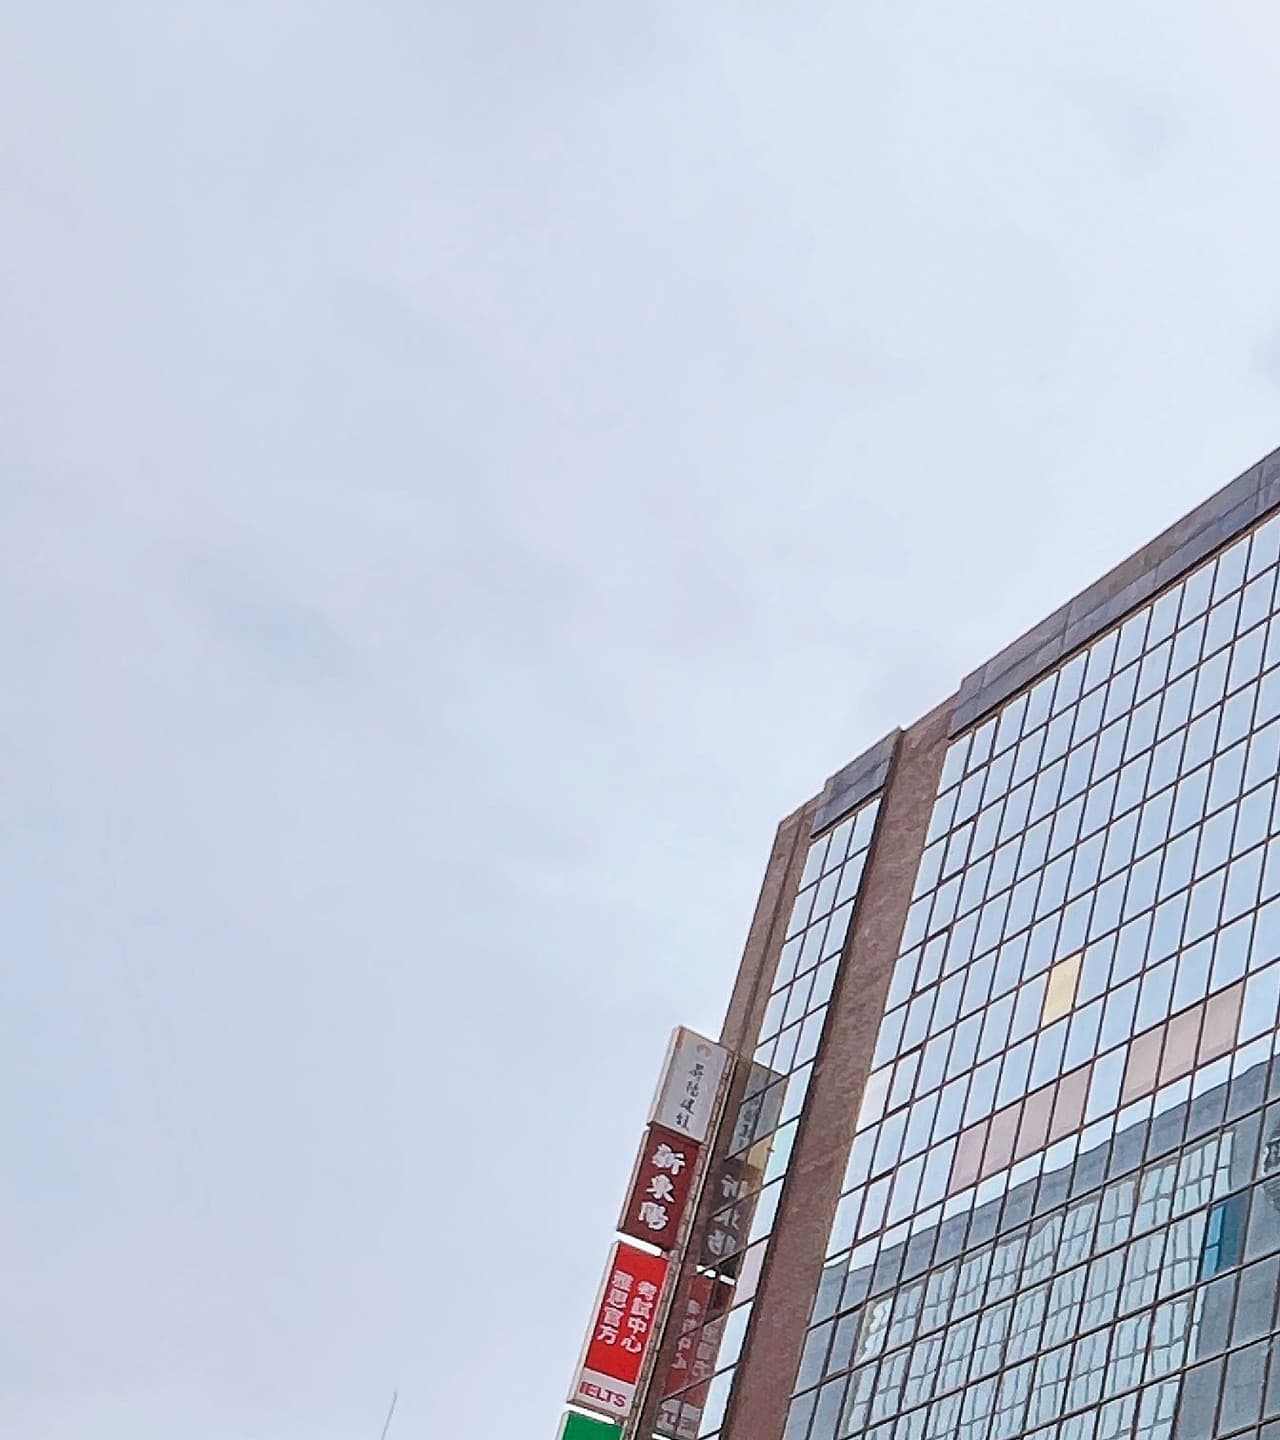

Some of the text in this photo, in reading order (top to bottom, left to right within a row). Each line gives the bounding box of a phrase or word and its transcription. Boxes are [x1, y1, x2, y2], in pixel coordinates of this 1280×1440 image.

[637, 1143, 686, 1231] 新東陽
[620, 1279, 659, 1355] 考試中心
[579, 1381, 627, 1408] IELTS
